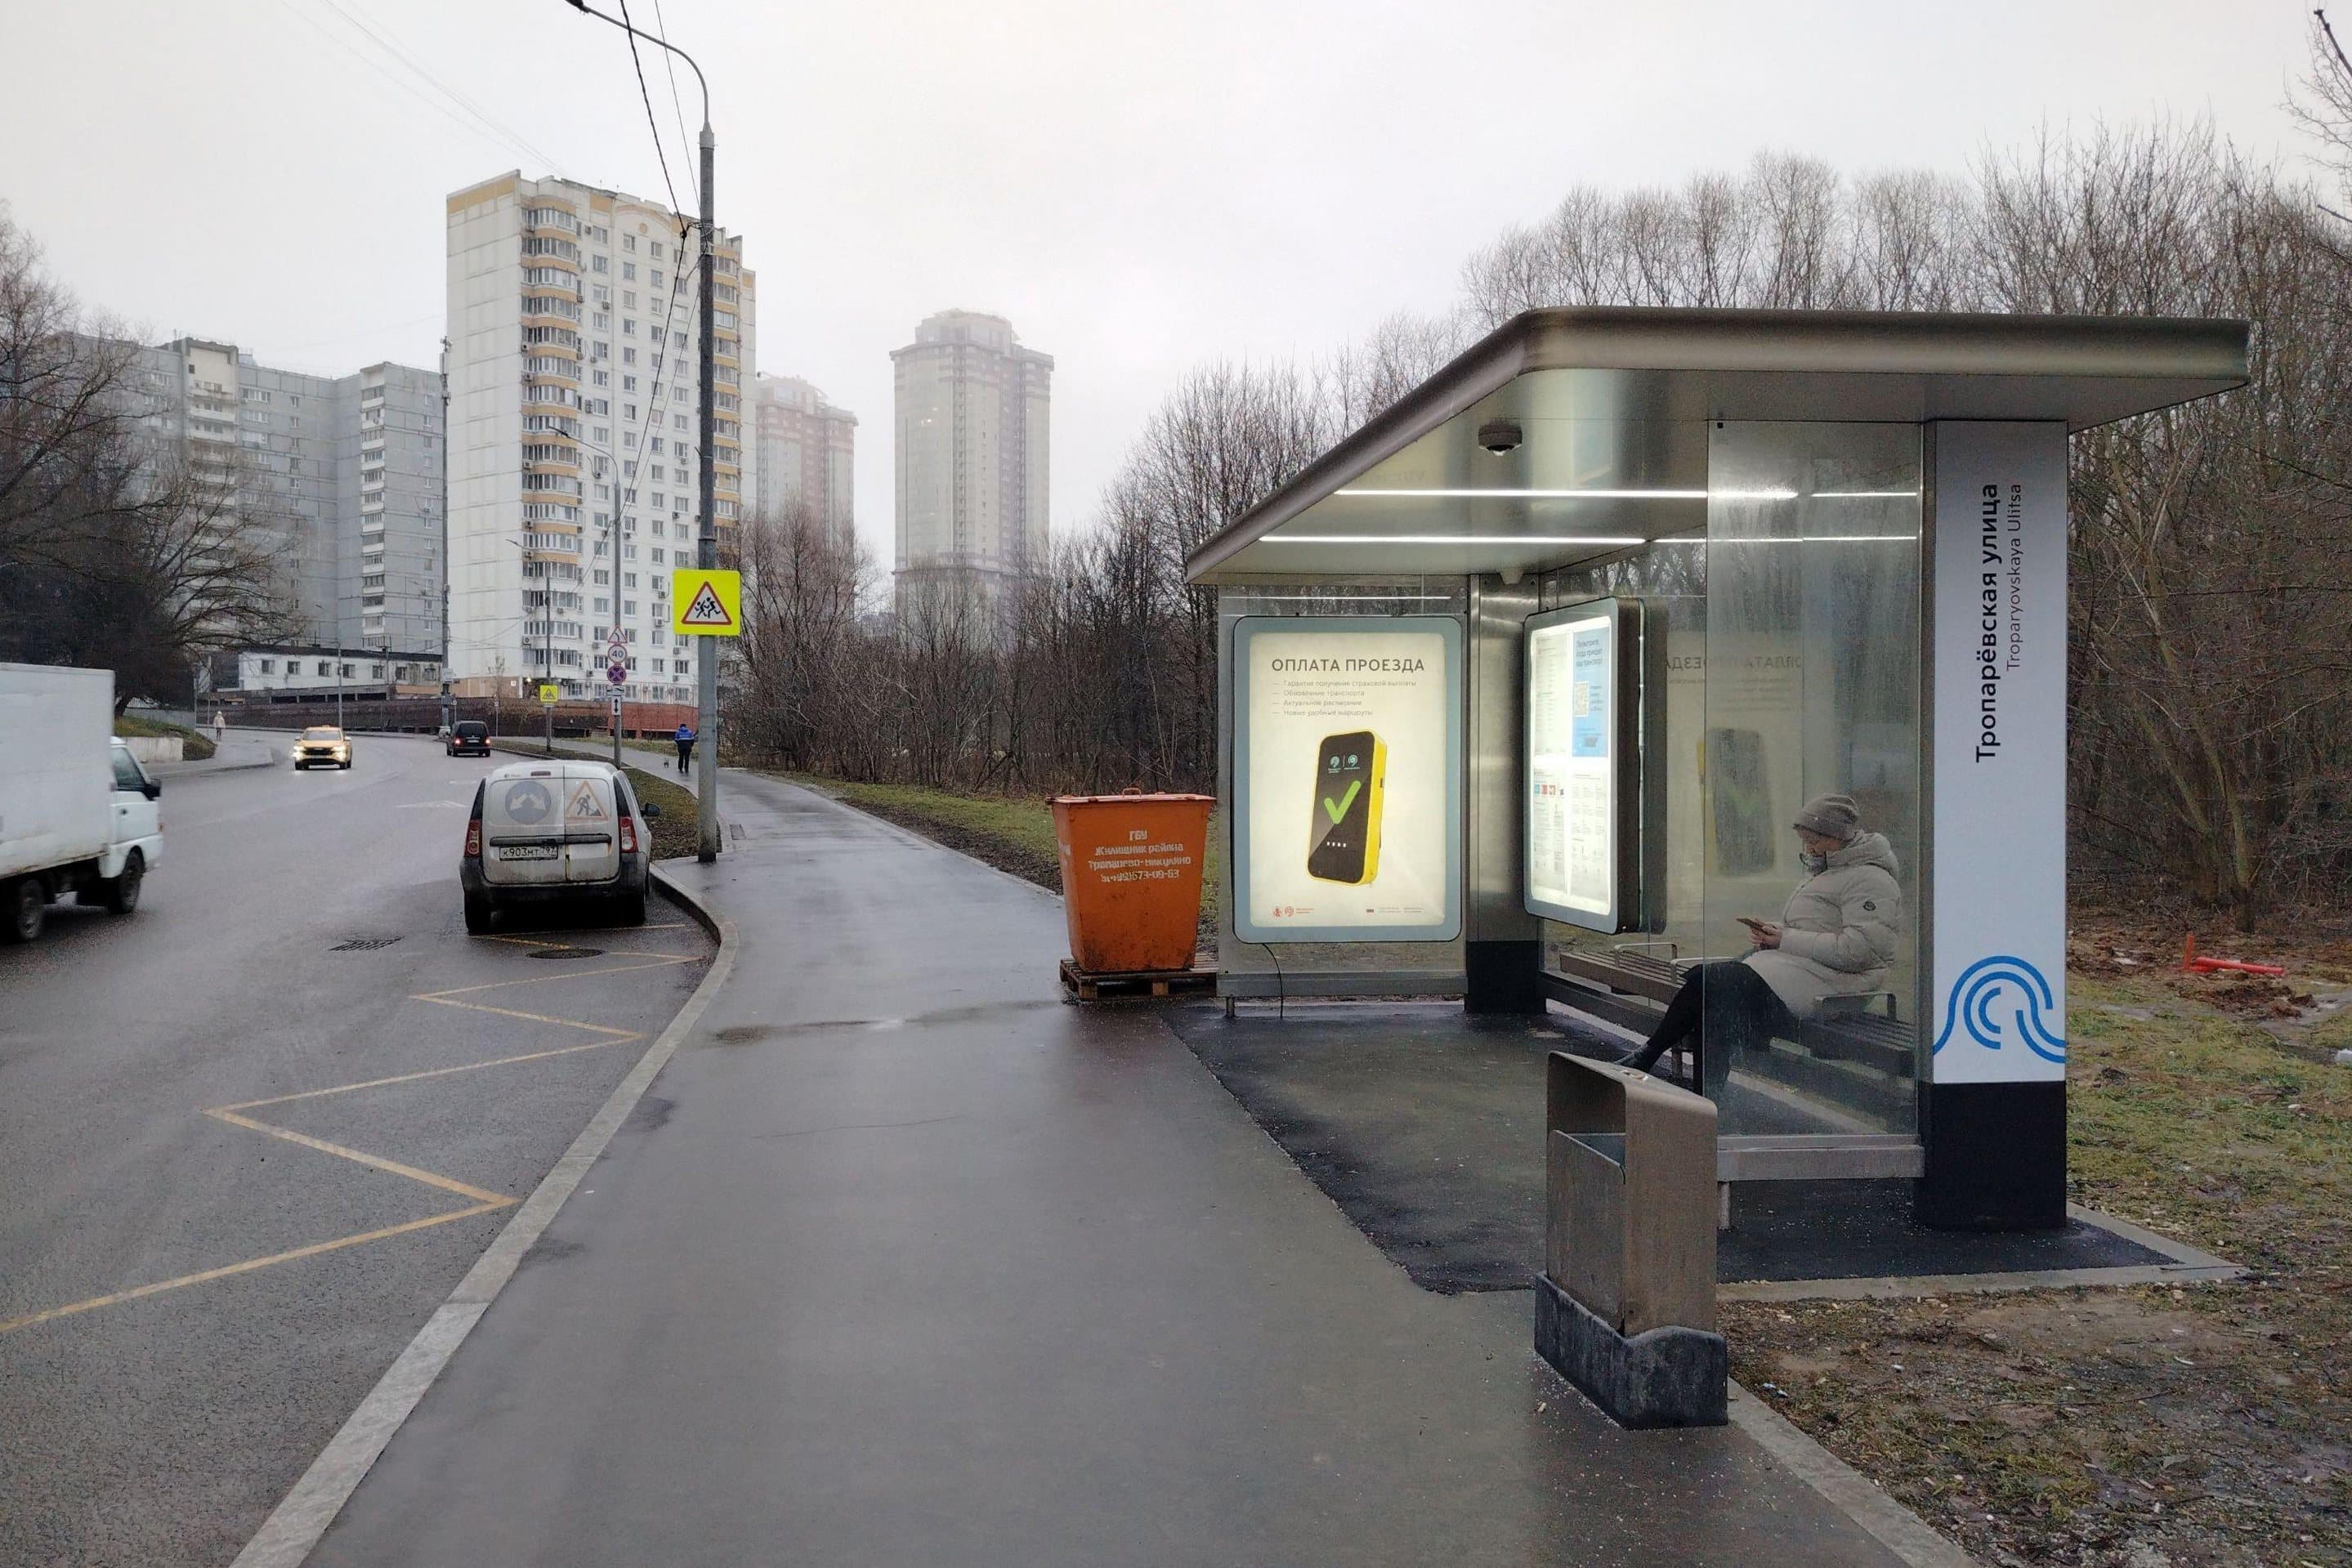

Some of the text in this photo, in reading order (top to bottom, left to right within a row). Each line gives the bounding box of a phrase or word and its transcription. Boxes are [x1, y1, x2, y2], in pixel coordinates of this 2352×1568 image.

[2006, 483, 2024, 671] Troparyovskaya Ulitsa
[1975, 483, 2002, 763] Тропарёвская улица
[612, 650, 624, 658] 40
[1272, 659, 1424, 673] ОПЛАТА ПРОЕЗДА
[1129, 830, 1147, 842] ГБУ
